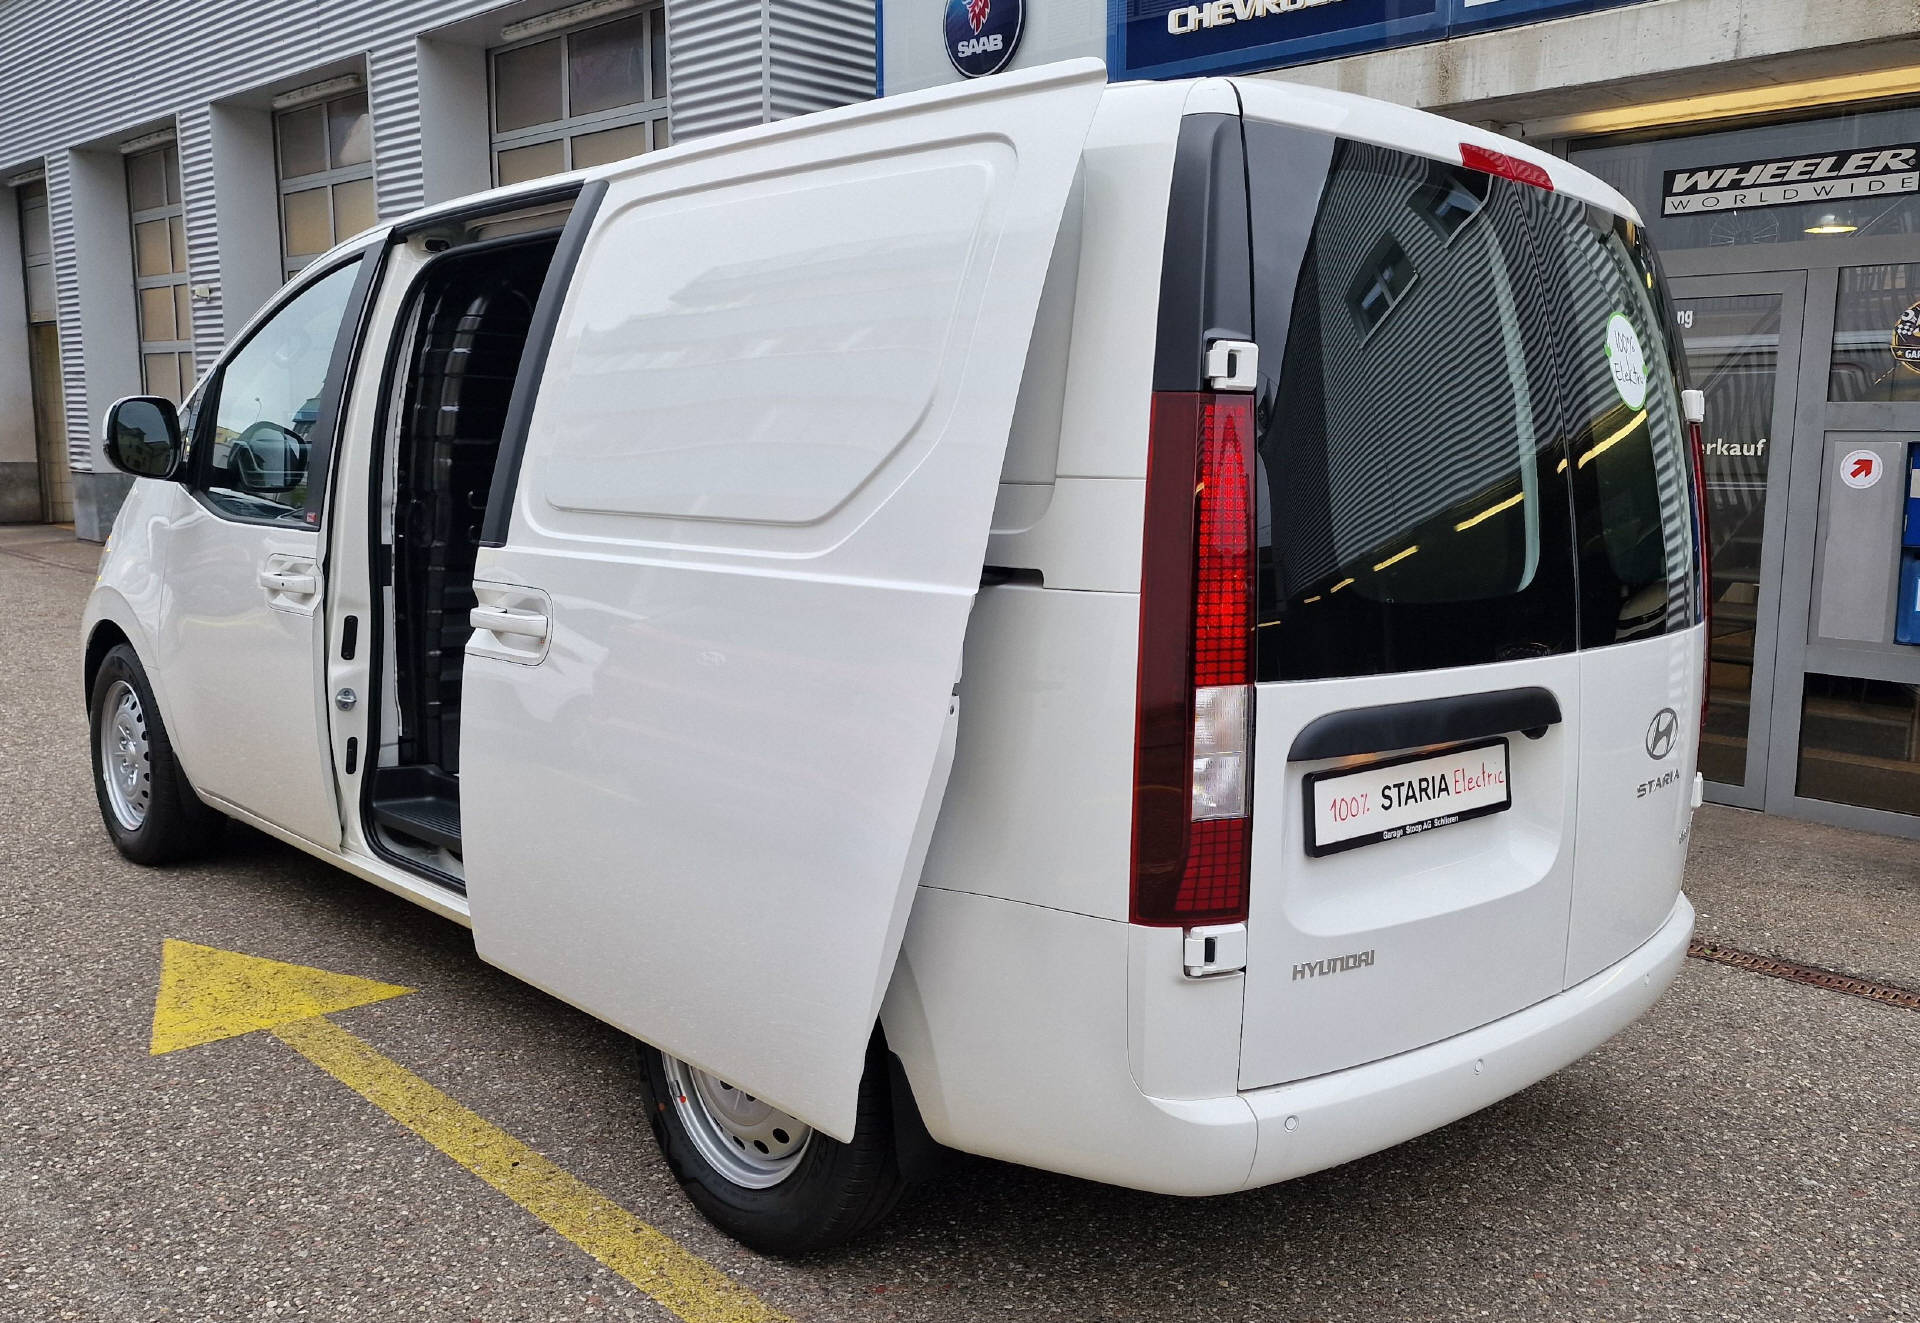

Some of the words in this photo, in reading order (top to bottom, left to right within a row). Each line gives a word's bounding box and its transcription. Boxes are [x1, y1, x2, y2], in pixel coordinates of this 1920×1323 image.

[957, 33, 1003, 58] SAAB
[1672, 149, 1916, 194] WHEELER
[1671, 176, 1913, 211] WORLDWIDE
[1614, 331, 1636, 354] 100%
[1329, 792, 1370, 823] 100%
[1381, 773, 1450, 811] STARIA
[1454, 761, 1505, 795] Electric
[1636, 768, 1680, 798] STARIA
[1382, 828, 1404, 840] Garage
[1423, 820, 1432, 830] AG
[1292, 949, 1375, 981] HYUNDAI
